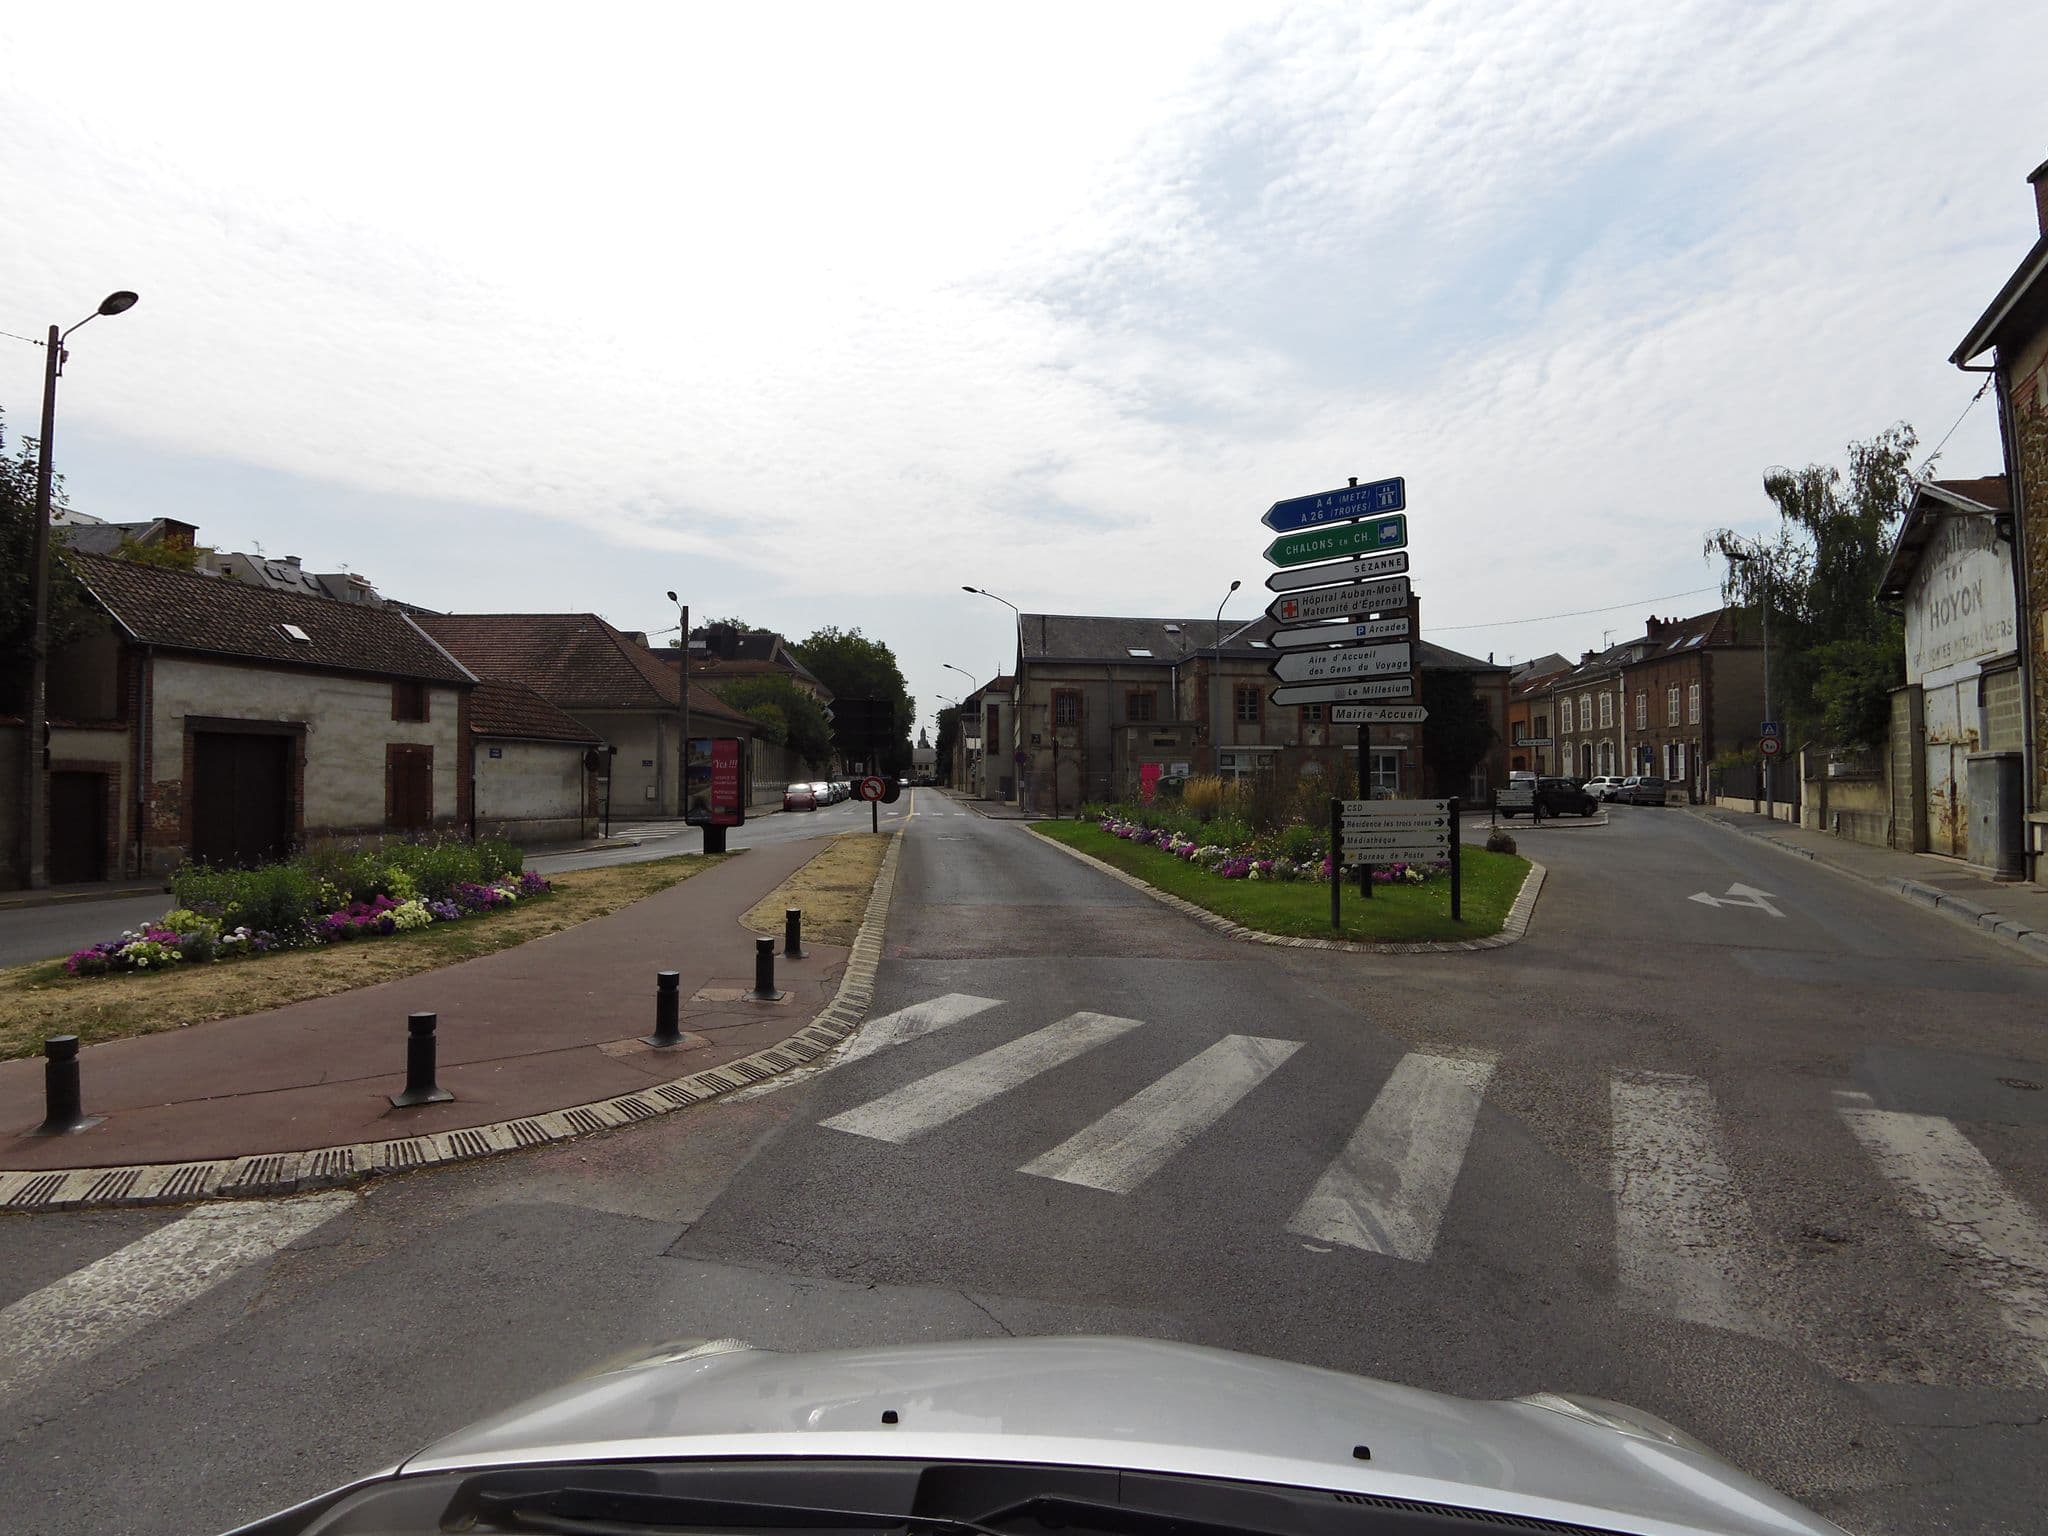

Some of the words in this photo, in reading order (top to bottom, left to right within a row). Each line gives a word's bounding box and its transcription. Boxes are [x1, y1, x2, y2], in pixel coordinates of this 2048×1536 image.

[1286, 539, 1333, 555] CHALONS
[1354, 558, 1402, 573] SÉZANNE
[1302, 592, 1337, 606] Hôpital
[1341, 584, 1401, 600] Auban-Moël
[1303, 603, 1349, 617] Maternité
[1930, 578, 1983, 632] HOYON
[1369, 622, 1406, 634] Arcades
[1308, 656, 1327, 665] Aire
[1332, 651, 1376, 662] d'Accueil
[1309, 667, 1324, 676] des
[1330, 665, 1352, 674] Gens
[1358, 663, 1369, 672] du
[1375, 660, 1408, 671] Voyage
[1348, 688, 1358, 696] Le
[1362, 685, 1410, 695] Millesium
[1336, 708, 1423, 720] Mairie-Accueil
